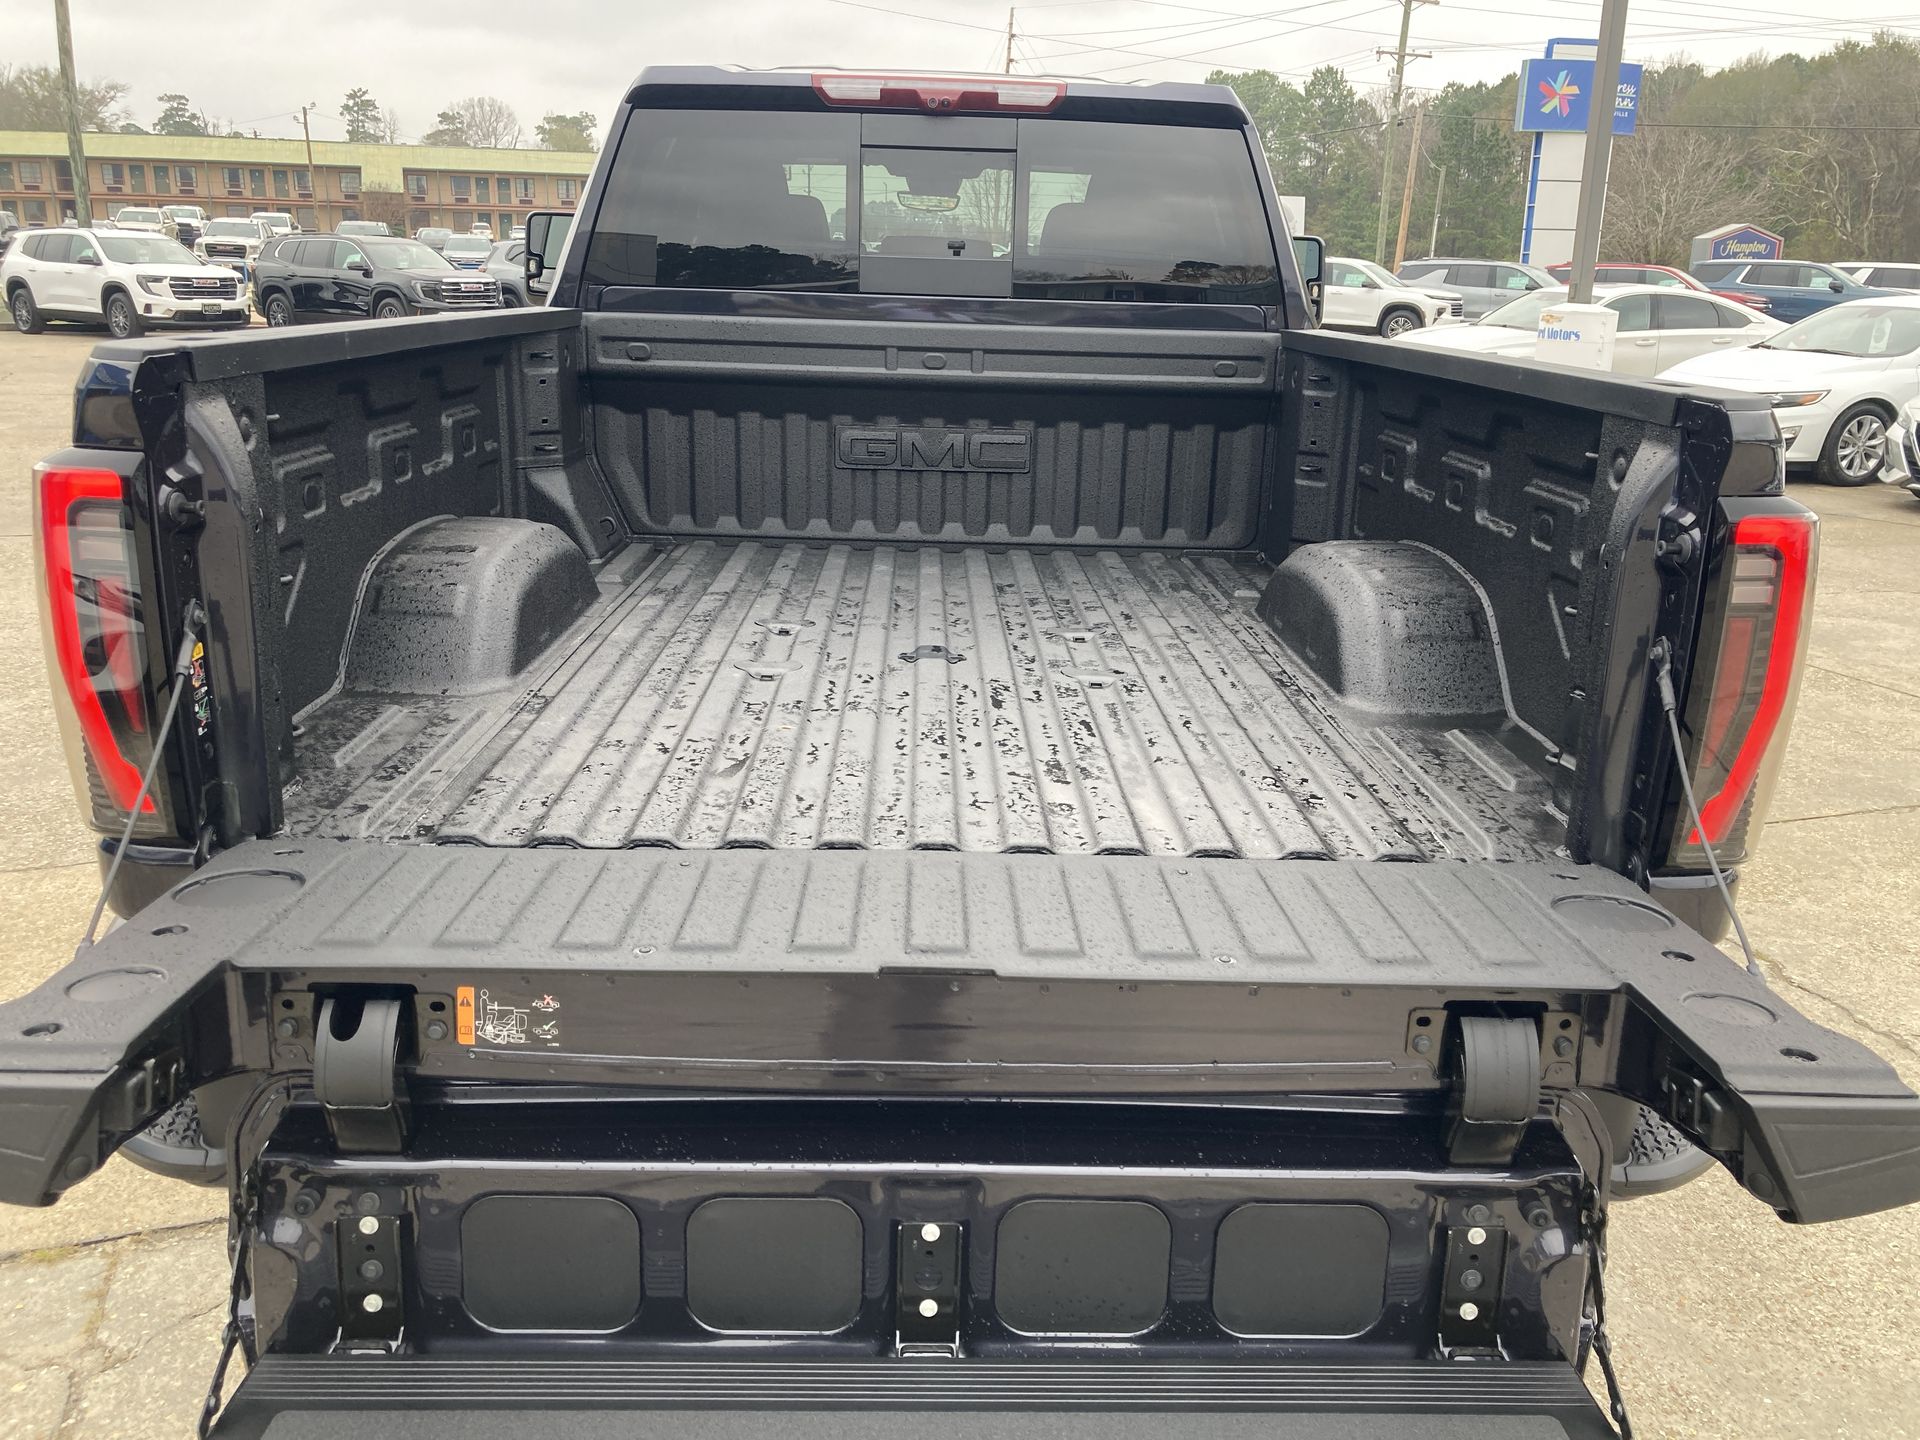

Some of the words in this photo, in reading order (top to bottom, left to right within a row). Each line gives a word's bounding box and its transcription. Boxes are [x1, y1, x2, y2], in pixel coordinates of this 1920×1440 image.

[1720, 239, 1770, 257] Hampton
[1547, 327, 1581, 341] Motors
[838, 430, 1027, 470] GMC
